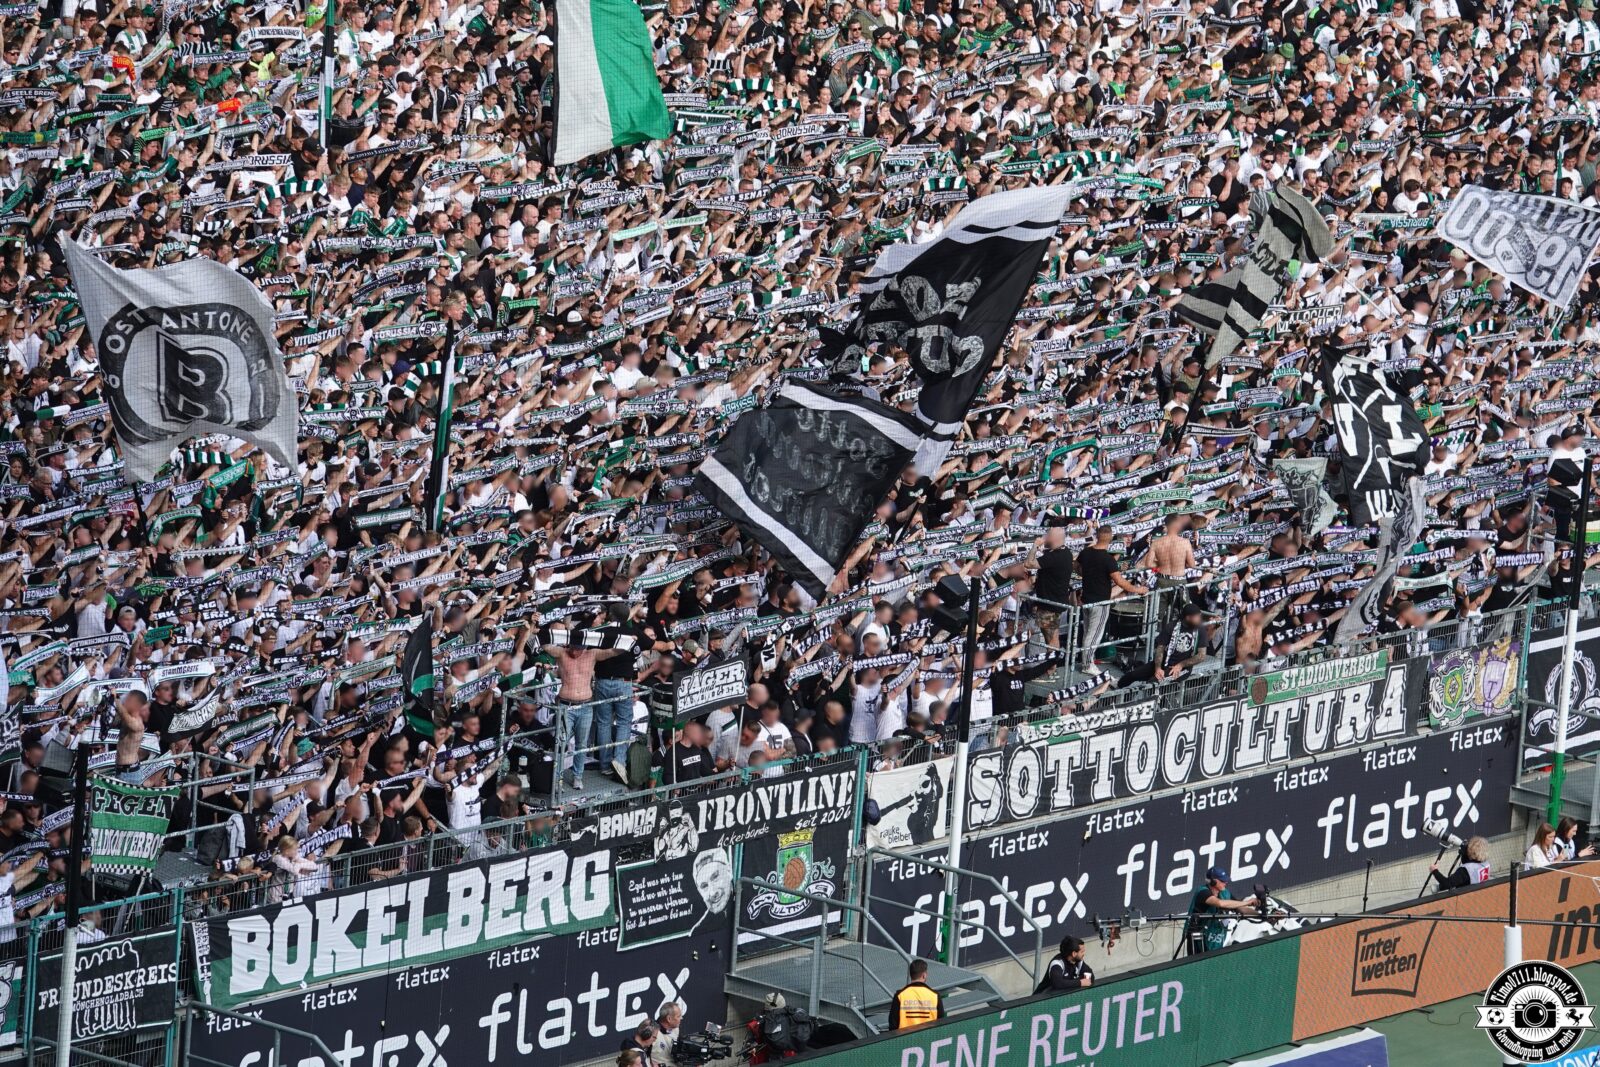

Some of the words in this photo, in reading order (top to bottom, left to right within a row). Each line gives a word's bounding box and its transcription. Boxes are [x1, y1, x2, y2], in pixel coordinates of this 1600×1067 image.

[106, 308, 147, 353] OST
[161, 310, 254, 345] ANTONE
[678, 662, 745, 695] JÄGER
[1053, 671, 1111, 699] ULTRAS
[1282, 653, 1379, 690] STADIONVERBOT
[968, 664, 1408, 830] SOTTOCULTURA
[1450, 726, 1503, 752] flatex
[1363, 745, 1417, 773] flatex
[1273, 766, 1329, 793] flatex
[92, 785, 176, 820] GEGEN
[698, 770, 856, 834] FRONTLINE
[1181, 786, 1239, 814] flatex
[600, 806, 658, 841] BANDA
[1317, 779, 1483, 860] flatex
[988, 831, 1049, 859] flatex
[1117, 824, 1294, 908] flatex
[227, 849, 611, 996] BÖKELBERG
[576, 927, 619, 949] flate
[487, 946, 541, 969] flatex
[1360, 932, 1400, 963] inter
[396, 966, 450, 991] flatex
[1361, 953, 1418, 983] wetten
[39, 962, 177, 1011] FRUNDESKREIS
[301, 987, 358, 1012] flatex
[1028, 980, 1184, 1067] REUTER
